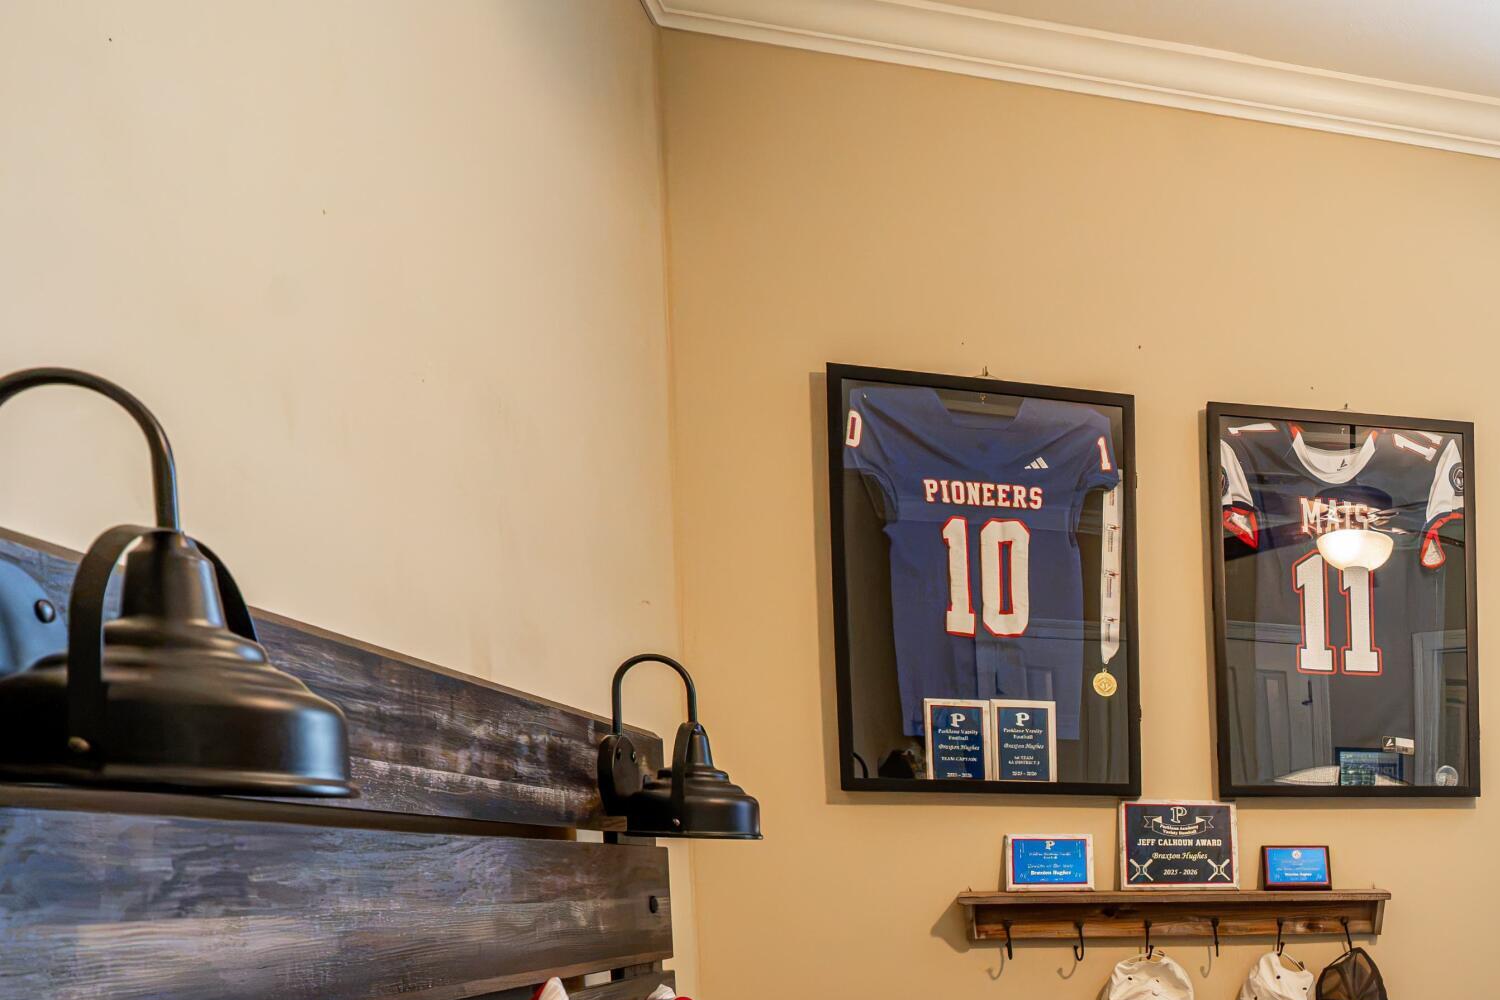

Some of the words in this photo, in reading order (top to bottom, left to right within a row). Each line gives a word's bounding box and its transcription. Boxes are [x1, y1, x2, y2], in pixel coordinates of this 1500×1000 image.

[1097, 436, 1111, 471] 1
[923, 479, 1043, 510] PIONEERS
[941, 514, 1030, 637] 10
[1292, 549, 1382, 676] 11
[950, 713, 966, 727] P
[1016, 712, 1030, 726] P
[1170, 806, 1187, 823] P
[1045, 840, 1055, 850] P
[1158, 839, 1193, 847] CALHOUN
[1195, 839, 1222, 847] AWARD
[1152, 852, 1180, 860] Braxton
[1181, 852, 1207, 861] Hughes
